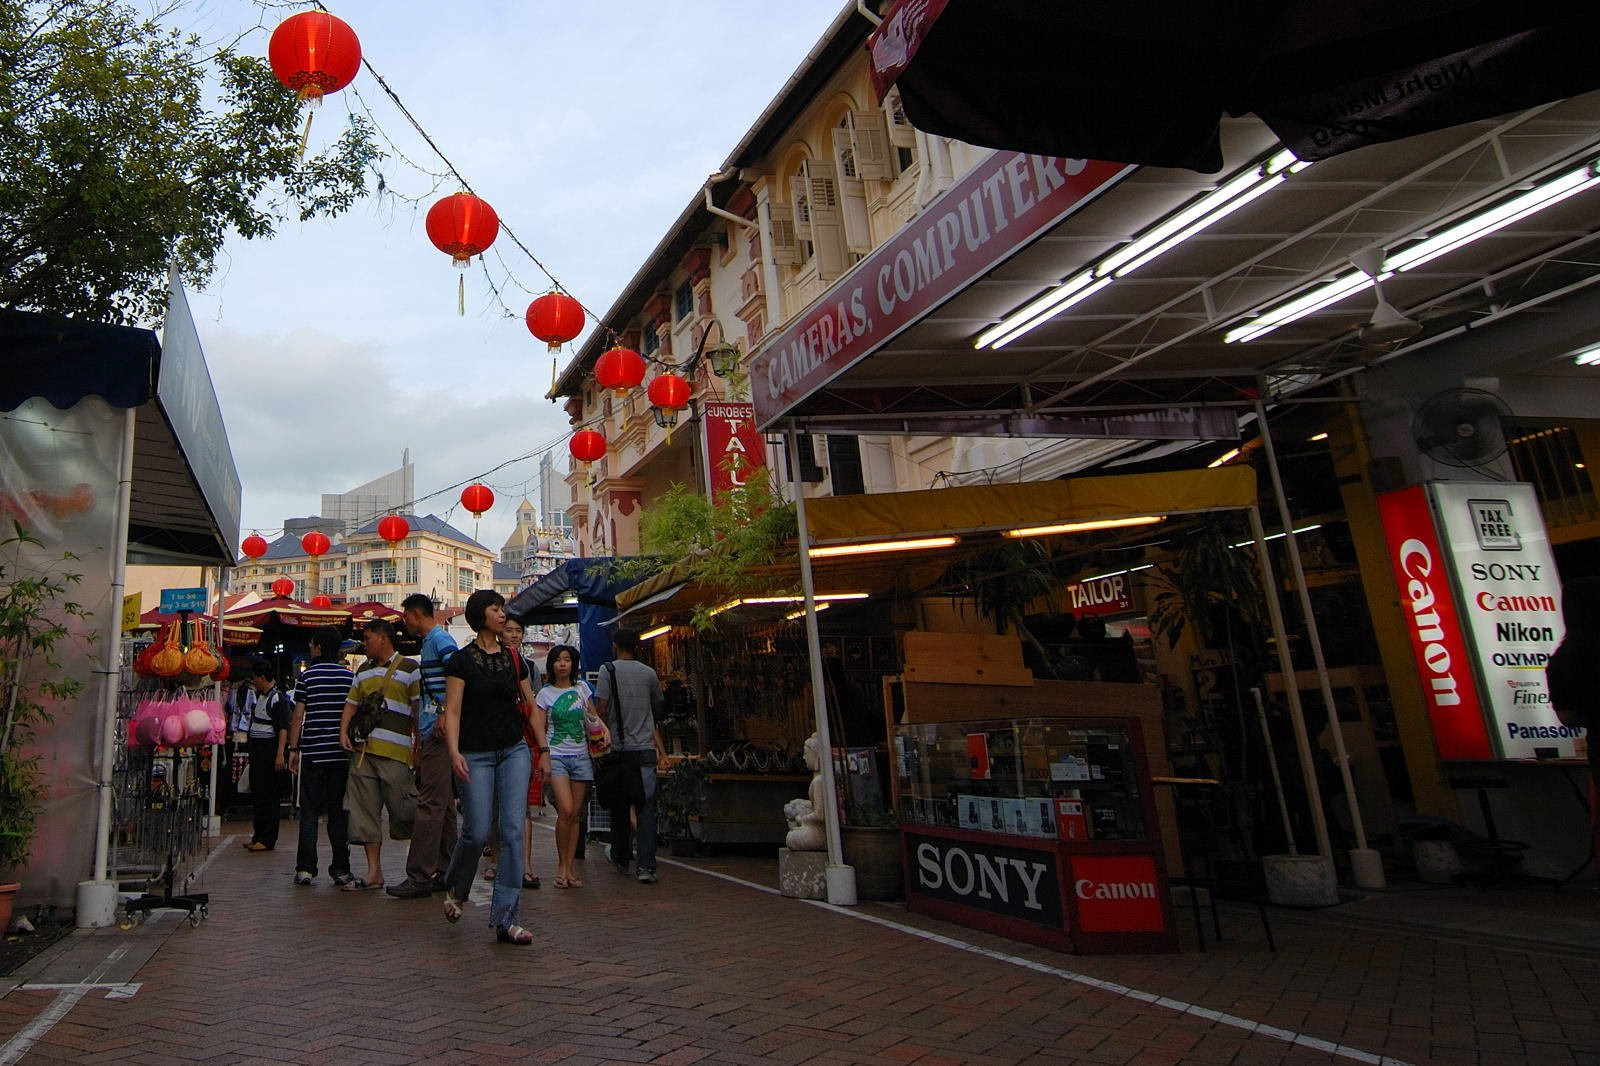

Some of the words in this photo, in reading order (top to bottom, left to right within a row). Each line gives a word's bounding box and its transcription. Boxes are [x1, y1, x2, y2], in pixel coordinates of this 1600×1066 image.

[767, 288, 874, 400] CAMERAS,
[707, 406, 754, 418] EUROBES
[1479, 509, 1504, 522] TAX
[1480, 523, 1511, 537] FREE
[1471, 563, 1541, 581] SONY
[1067, 576, 1127, 609] TAILOR
[1476, 591, 1556, 612] Canon
[1399, 538, 1461, 707] Canon
[1496, 622, 1553, 642] Nikon
[1493, 653, 1551, 667] OLYMP
[1513, 689, 1550, 705] Fine
[915, 842, 1048, 911] SONY
[1075, 878, 1156, 902] Canon
